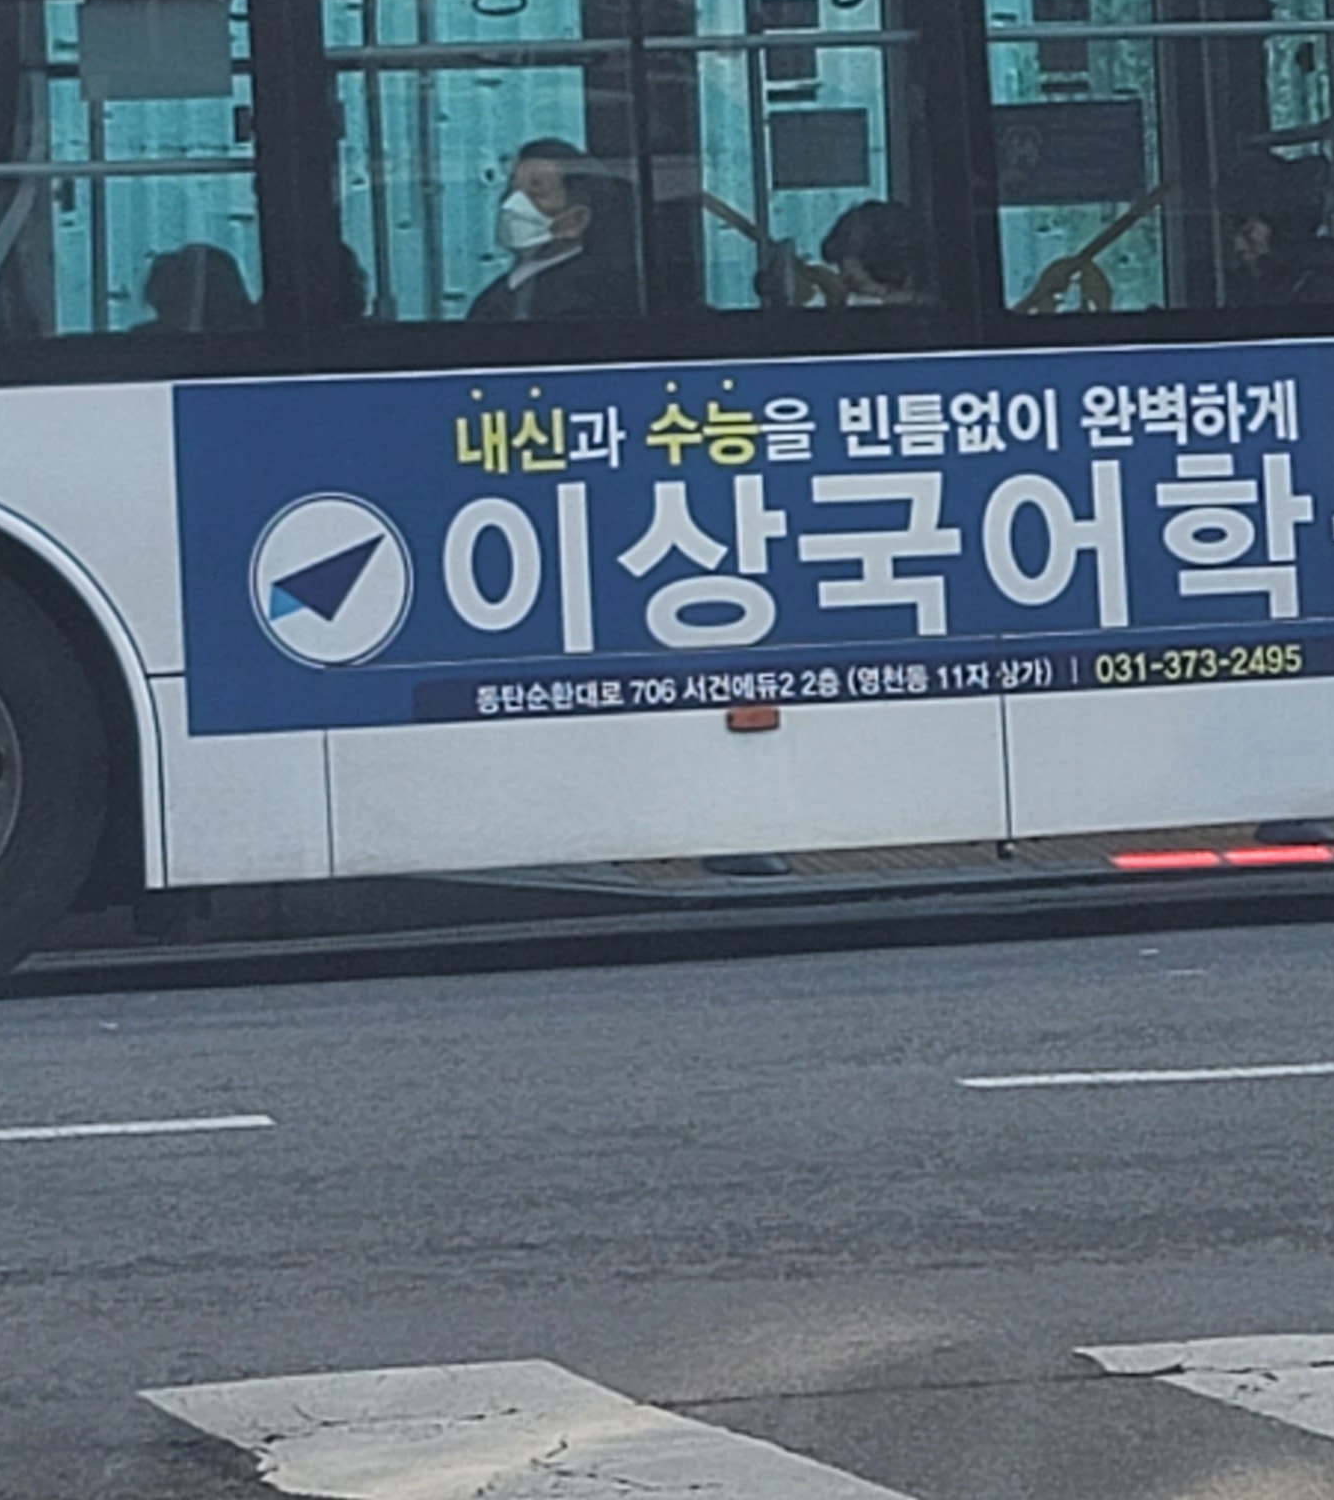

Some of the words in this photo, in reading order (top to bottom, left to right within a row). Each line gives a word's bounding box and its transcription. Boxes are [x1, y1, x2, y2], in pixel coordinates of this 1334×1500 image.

[456, 406, 627, 473] 내신과
[646, 398, 816, 466] 수능을
[838, 388, 1059, 458] 빈틈없이
[1080, 379, 1300, 447] 완벽하게
[477, 680, 625, 714] 동탄순환대로
[629, 679, 676, 705] 706
[801, 670, 842, 698] 2층
[999, 655, 1053, 689] 상가)
[1095, 644, 1303, 684] 031-373-2495
